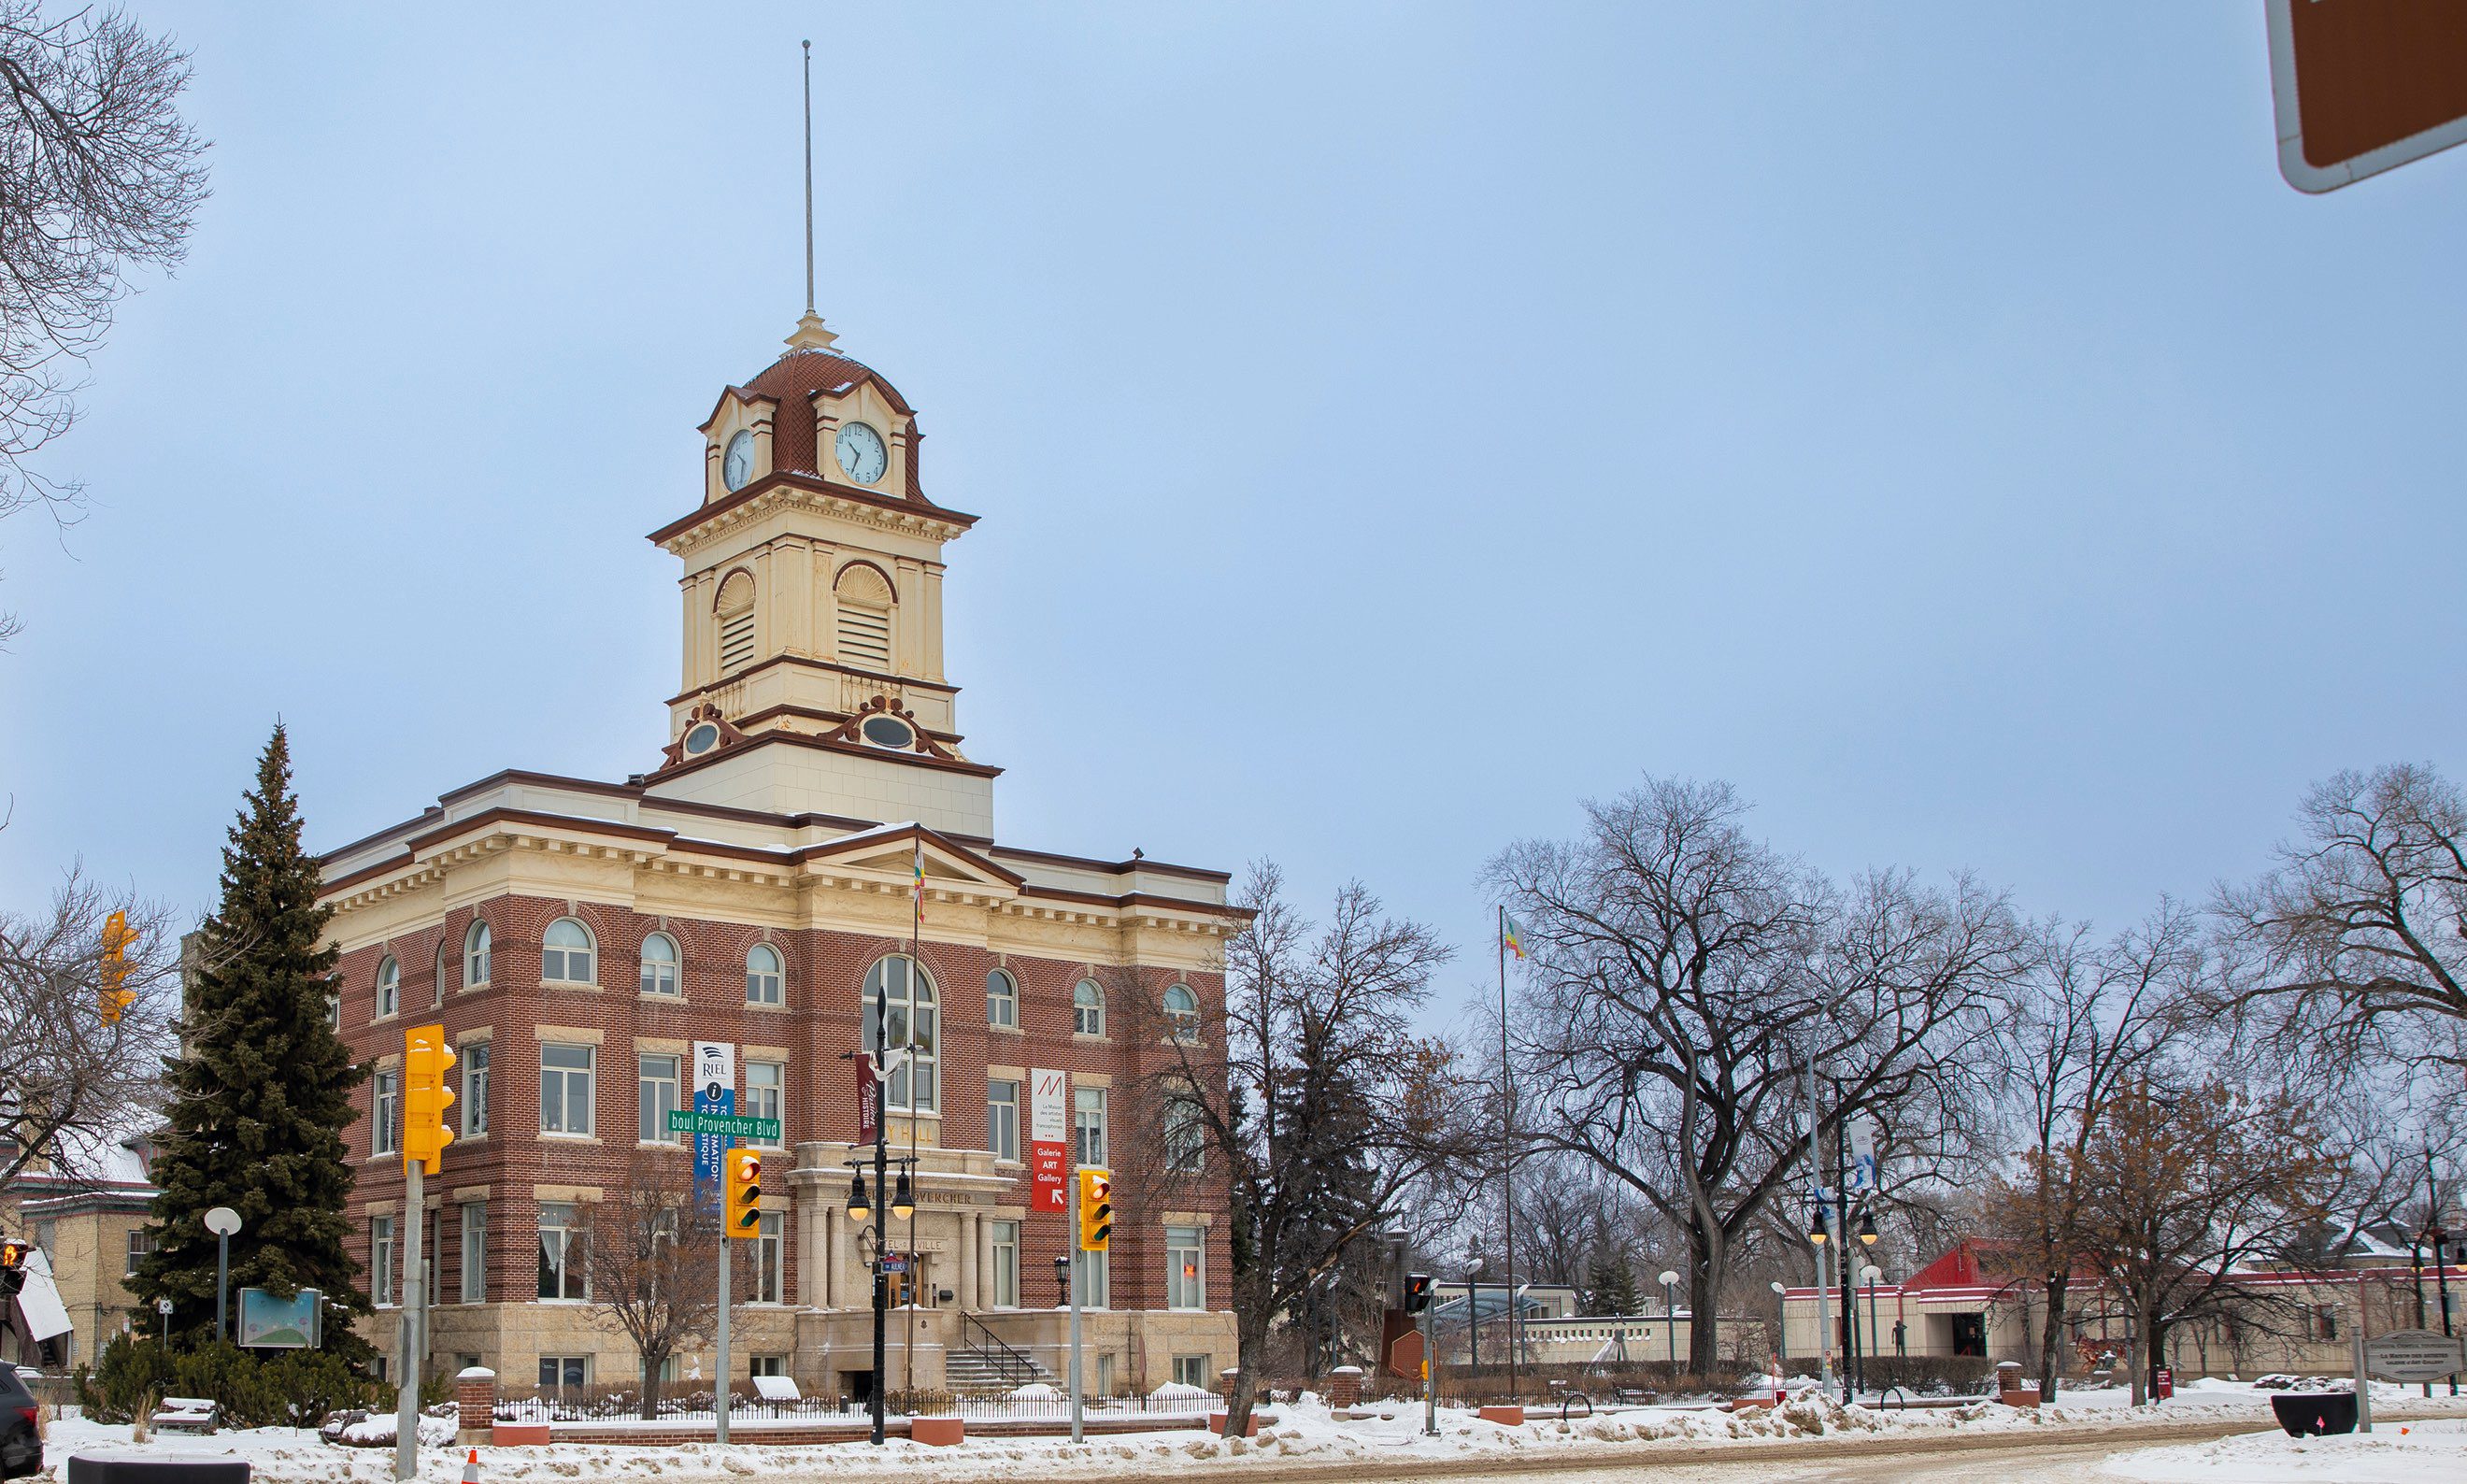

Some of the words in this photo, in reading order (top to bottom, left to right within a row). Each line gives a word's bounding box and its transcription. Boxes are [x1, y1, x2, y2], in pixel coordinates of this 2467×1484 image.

[703, 1063, 726, 1077] RIEL
[672, 1114, 694, 1131] boul
[698, 1116, 753, 1136] Provencher
[756, 1121, 777, 1137] Blvd
[901, 1125, 933, 1143] HLL
[1037, 1148, 1062, 1158] Galerie
[1042, 1161, 1058, 1170] ART
[1037, 1173, 1062, 1184] Gallery
[917, 1240, 942, 1250] VILLE
